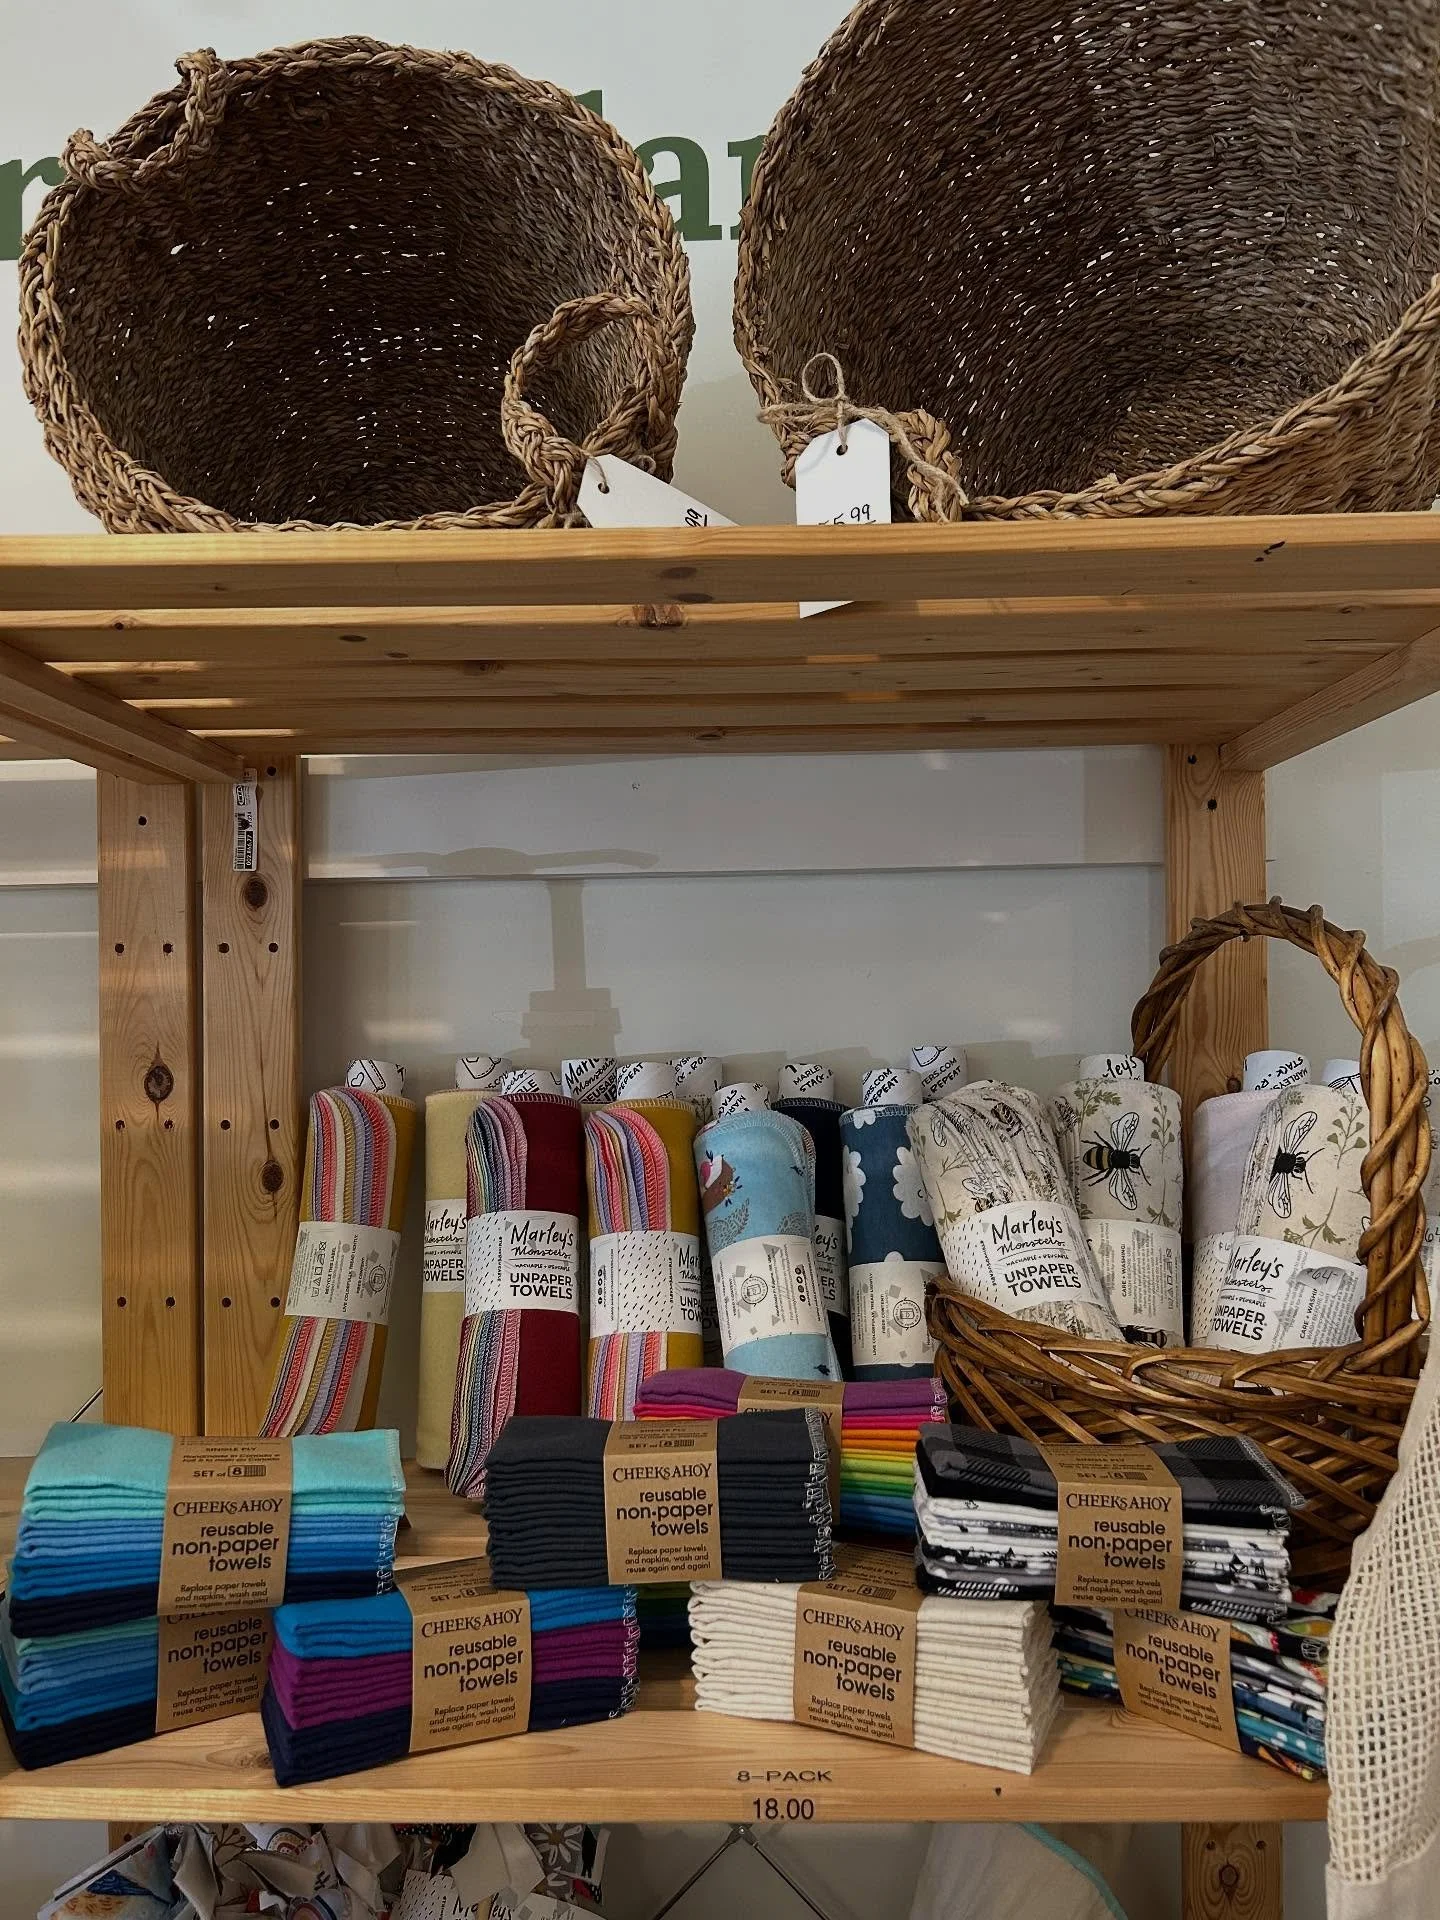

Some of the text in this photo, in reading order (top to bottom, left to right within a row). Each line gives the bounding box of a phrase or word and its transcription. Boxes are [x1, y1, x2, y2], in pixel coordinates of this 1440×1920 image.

[510, 1220, 573, 1249] Marley's
[992, 1210, 1063, 1244] Marley's
[510, 1272, 572, 1286] UNPAPER
[1004, 1263, 1076, 1283] UNPAPER
[510, 1284, 573, 1300] TOWELS
[1008, 1275, 1081, 1296] TOWELS
[613, 1463, 713, 1483] CHEEKS AHOY
[639, 1487, 707, 1502] reusable
[1066, 1493, 1172, 1512] CHEEKS AHOY
[173, 1498, 283, 1516] CHEEKS AHOY
[200, 1521, 274, 1537] reusable
[650, 1519, 709, 1536] towels
[1094, 1520, 1166, 1535] reusable
[209, 1553, 272, 1572] towels
[1104, 1552, 1166, 1570] towels
[194, 1617, 263, 1641] reusable
[421, 1608, 524, 1638] CHEEKS AHOY
[803, 1608, 905, 1641] CHEEKS AHOY
[1180, 1619, 1220, 1642] AHOY
[449, 1634, 517, 1657] reusable
[828, 1639, 897, 1663] reusable
[1148, 1633, 1214, 1663] reusable
[203, 1649, 262, 1674] towels
[459, 1668, 518, 1693] towels
[836, 1672, 895, 1701] towels
[1159, 1668, 1217, 1699] towels
[737, 1770, 833, 1781] 8-PACK
[753, 1797, 814, 1820] 18.00
